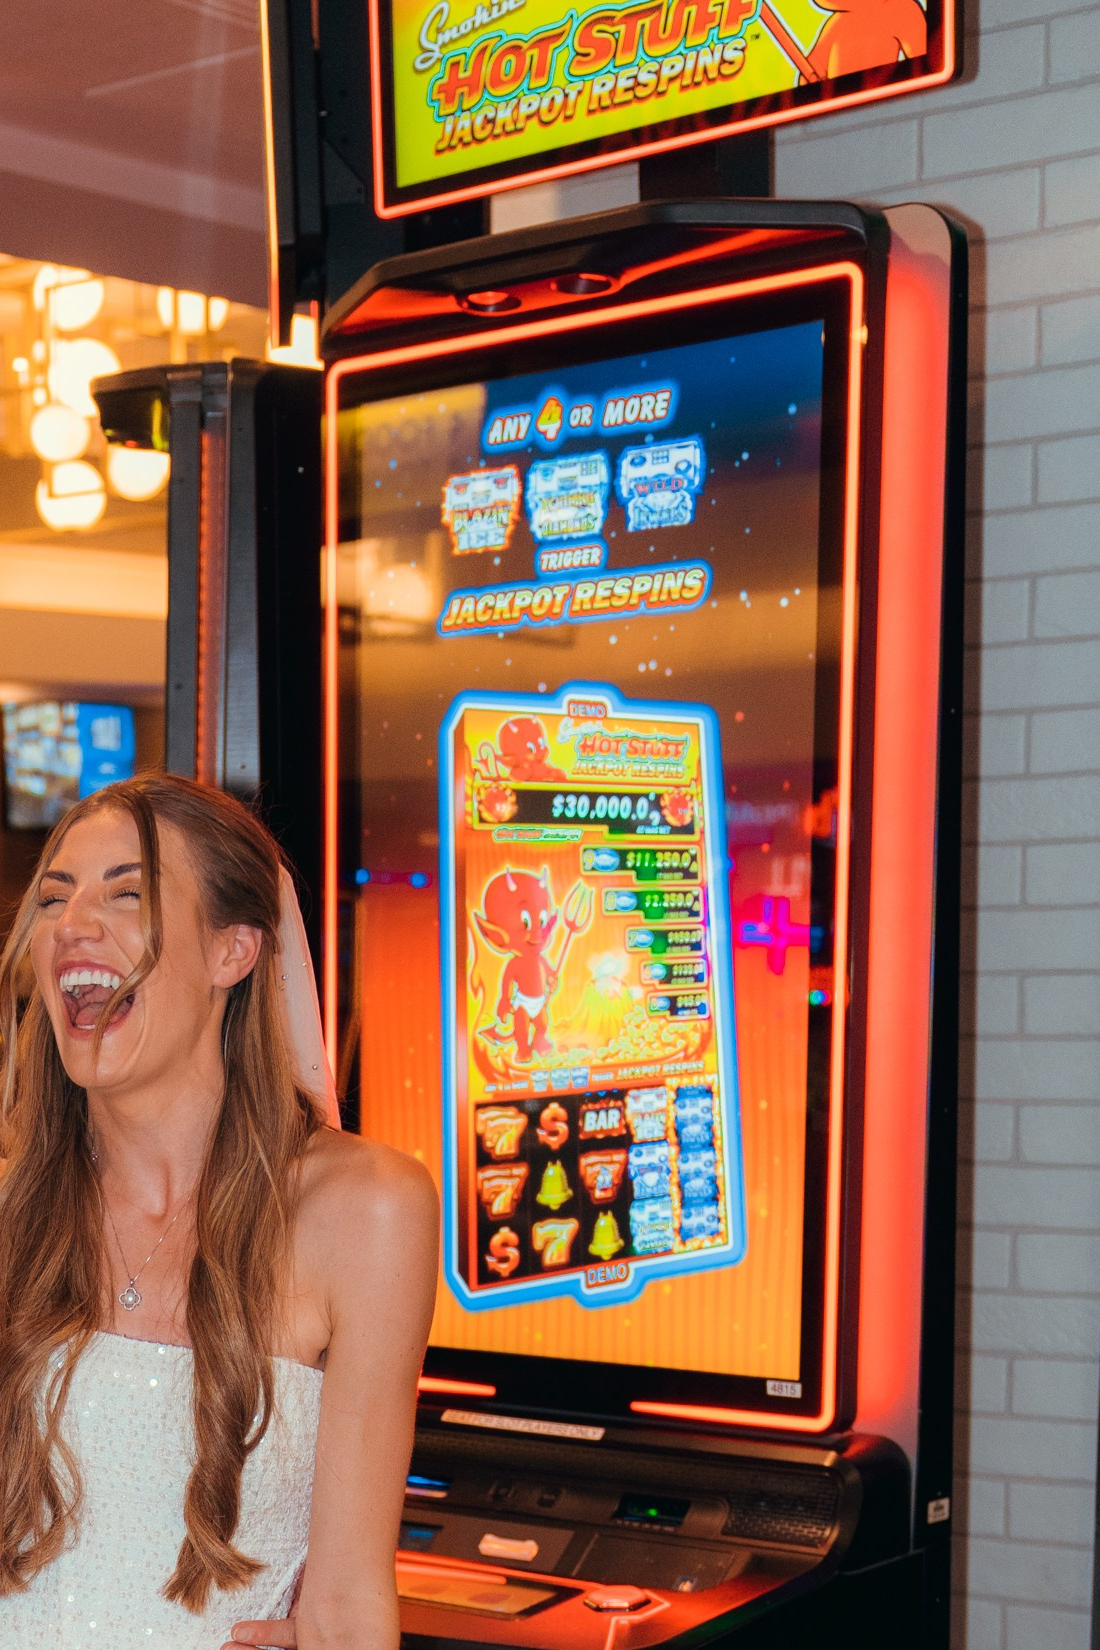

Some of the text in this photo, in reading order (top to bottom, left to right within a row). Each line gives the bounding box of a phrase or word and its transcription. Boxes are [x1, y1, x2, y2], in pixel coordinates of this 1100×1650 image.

[436, 0, 757, 117] HOT STUFF
[434, 83, 583, 155] JACKPOT
[586, 37, 747, 113] RESPINS
[488, 389, 671, 445] ANY 4 OR MORE
[540, 545, 601, 571] TRIGGER
[441, 569, 706, 631] JACKPOT RESPINS
[569, 702, 606, 717] DEMO
[579, 731, 687, 761] HOT STUFF
[584, 1110, 621, 1132] BAR
[587, 1263, 629, 1286] DEMO
[771, 1383, 797, 1396] 4815
